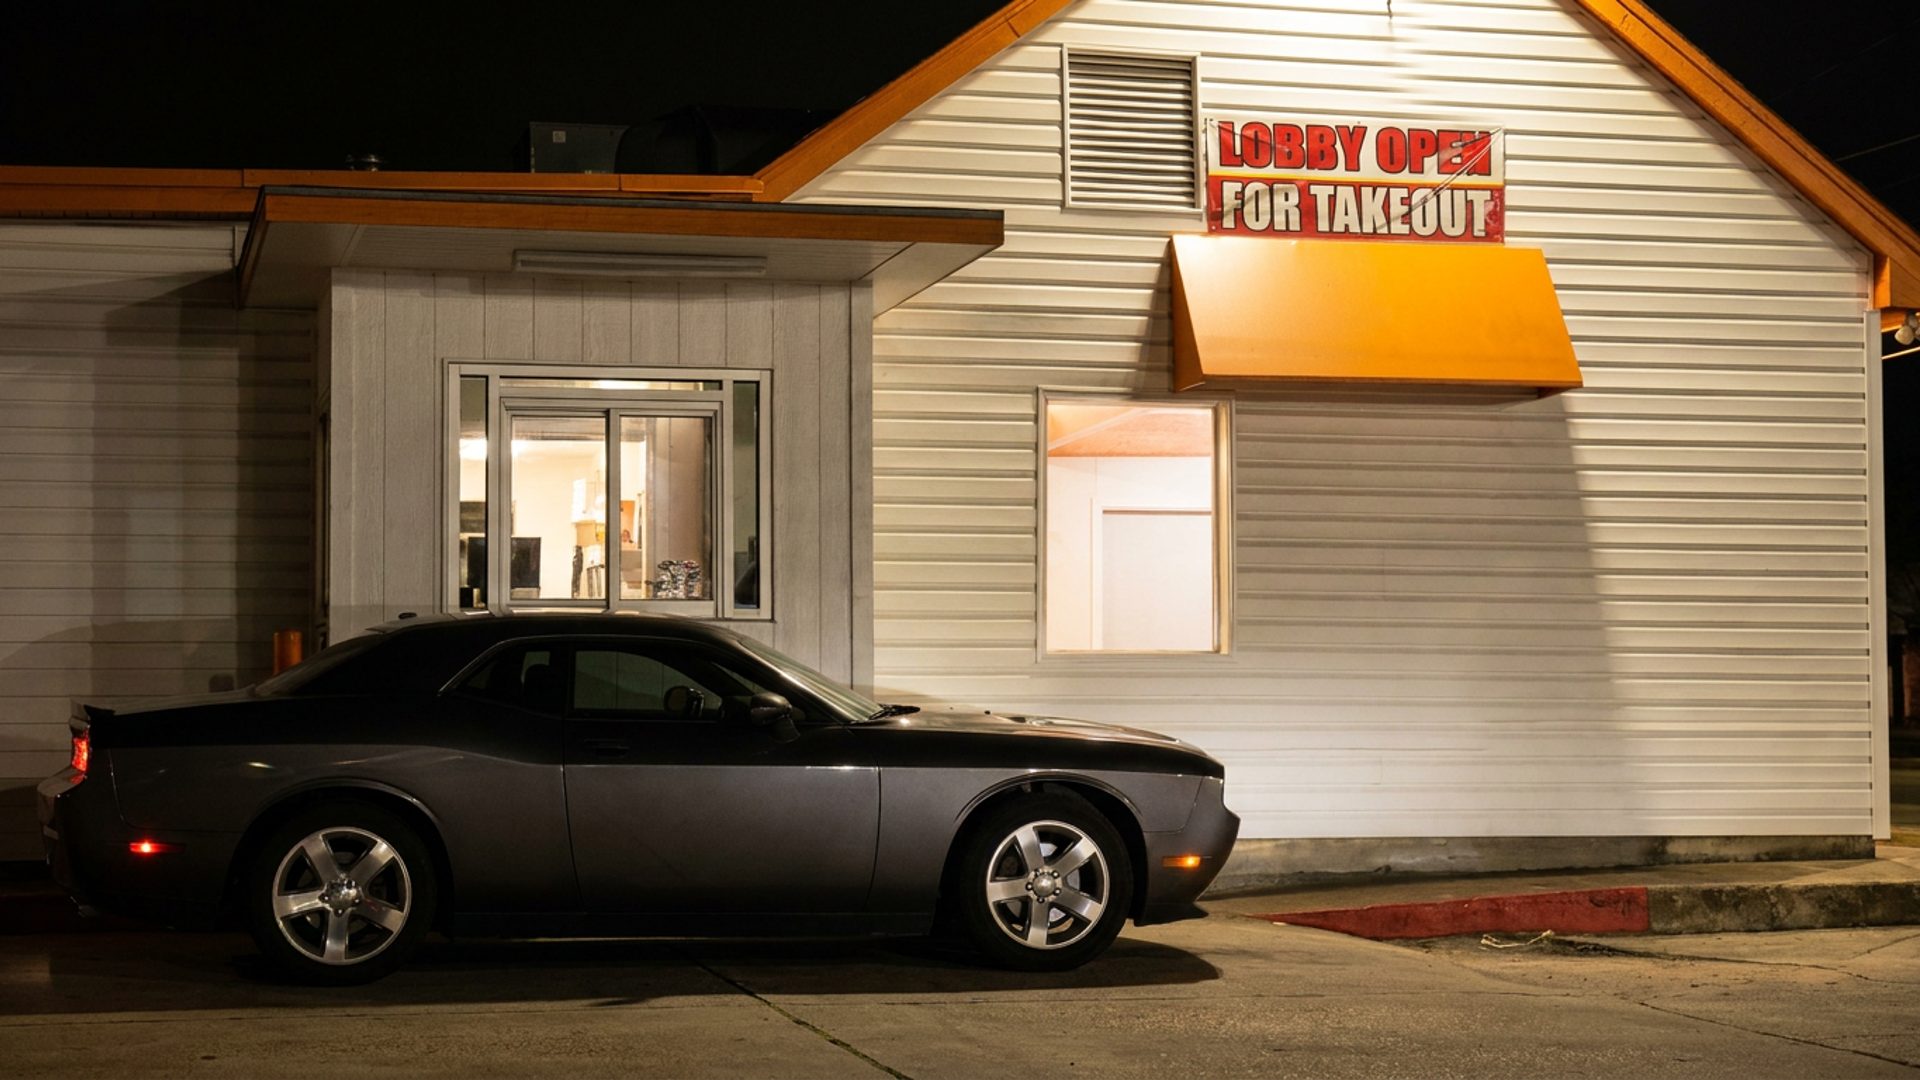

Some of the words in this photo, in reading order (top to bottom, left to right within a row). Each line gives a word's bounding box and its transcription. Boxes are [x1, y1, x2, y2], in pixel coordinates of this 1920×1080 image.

[1218, 120, 1368, 172] LOBBY
[1376, 126, 1492, 176] OPEN
[1221, 180, 1301, 232] FOR
[1308, 183, 1492, 238] TAKEOUT
